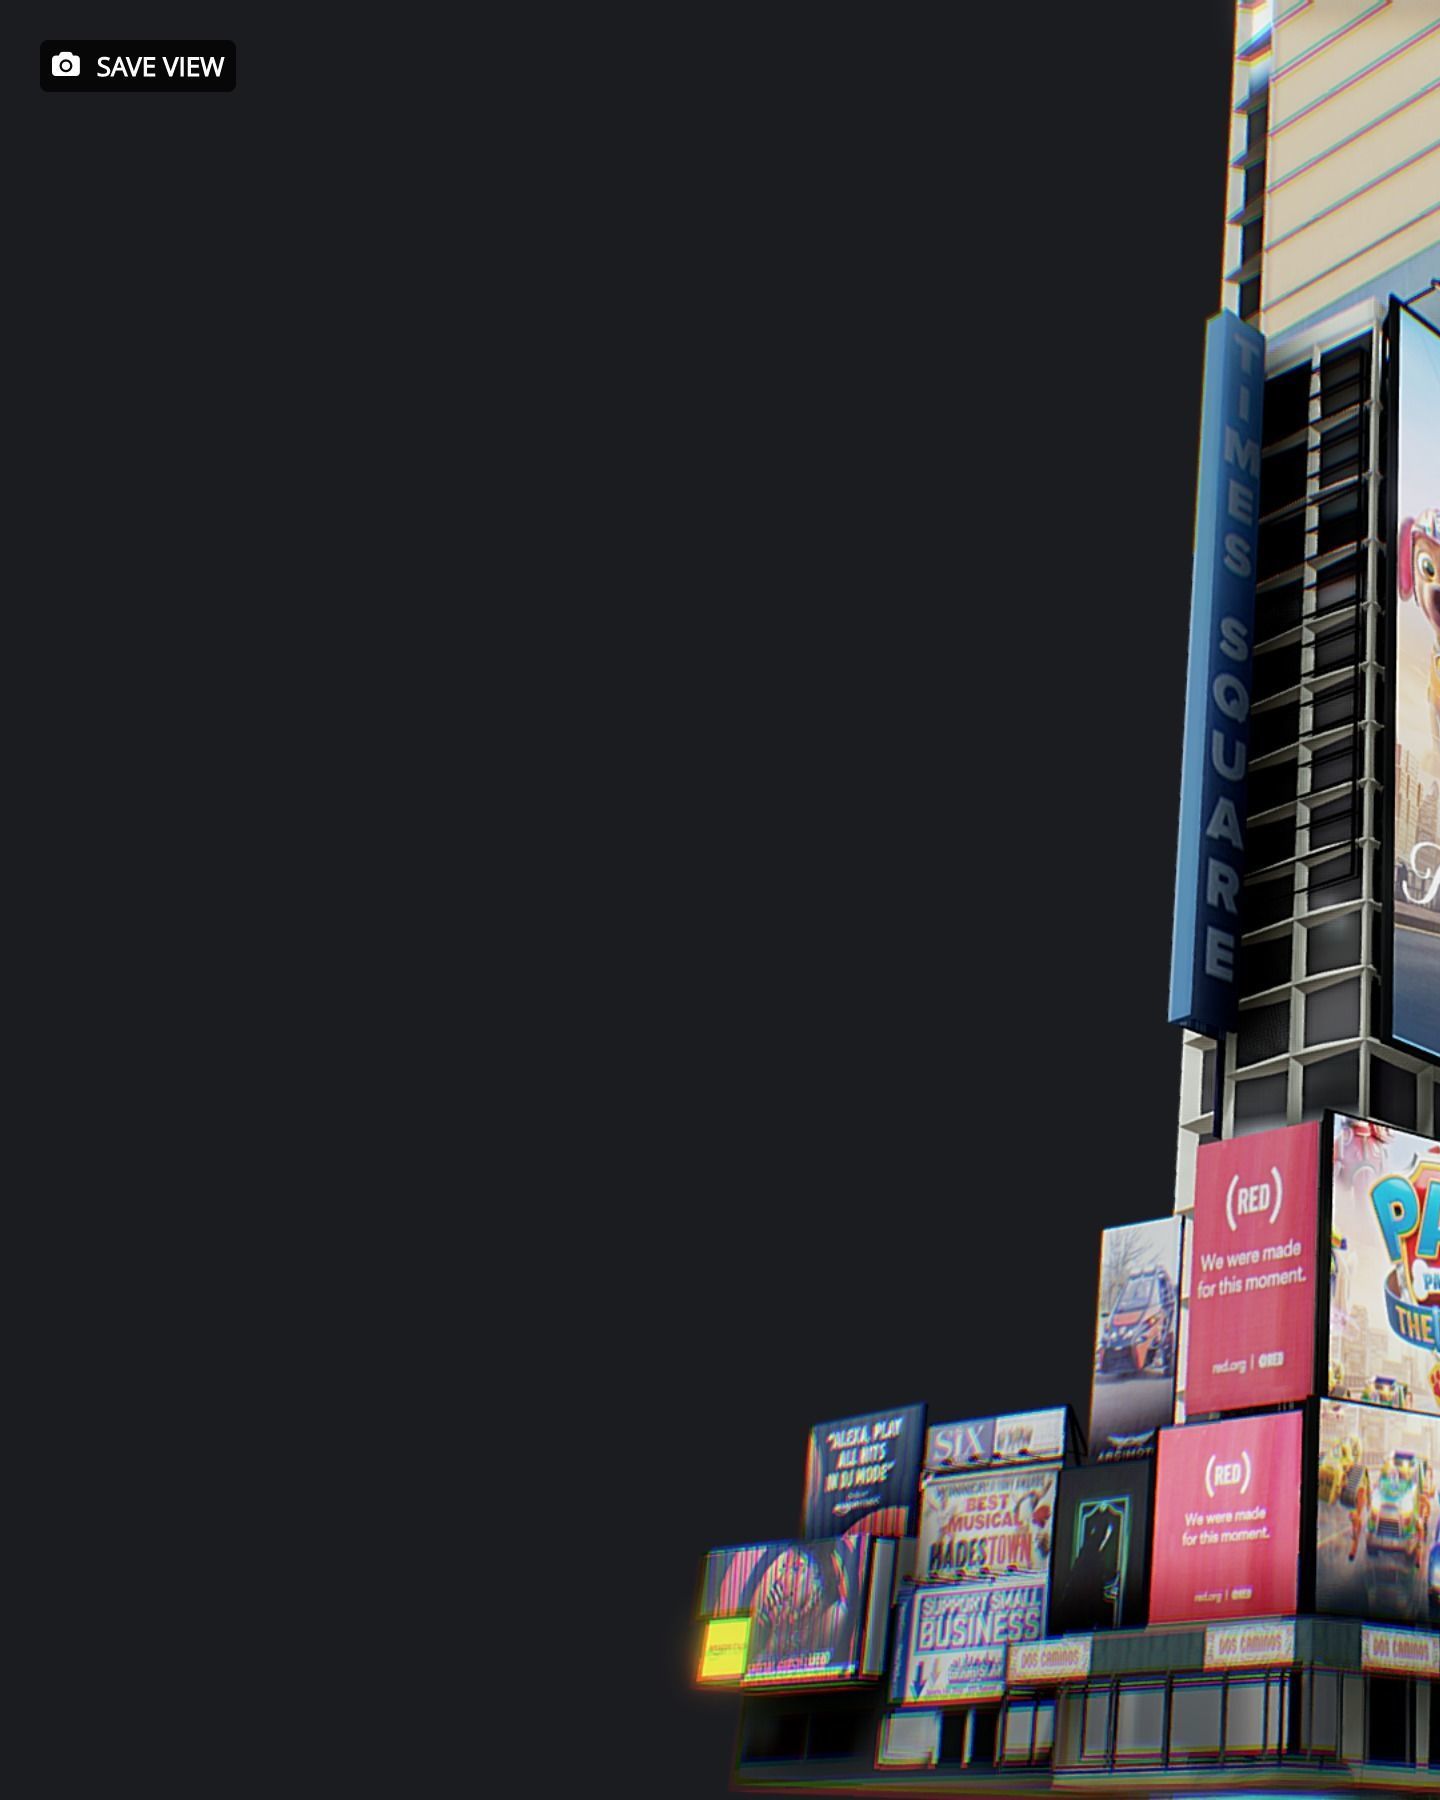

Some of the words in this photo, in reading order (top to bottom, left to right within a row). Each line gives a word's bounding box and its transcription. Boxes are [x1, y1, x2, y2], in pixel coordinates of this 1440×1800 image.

[1222, 332, 1261, 578] TIMES
[1206, 616, 1250, 983] SQUARE
[1226, 1166, 1283, 1232] (RED)
[1201, 1252, 1224, 1272] We
[1227, 1249, 1259, 1268] were
[1262, 1239, 1302, 1262] made
[1197, 1281, 1216, 1299] for
[1219, 1275, 1243, 1295] this
[1245, 1267, 1307, 1290] moment.
[1395, 1305, 1435, 1344] THE
[1204, 1450, 1252, 1498] (RED)
[964, 1493, 1010, 1513] BEST
[1184, 1512, 1203, 1527] We
[1206, 1510, 1233, 1524] were
[1234, 1506, 1267, 1521] made
[947, 1510, 1024, 1533] MUSICAL
[1182, 1532, 1197, 1546] for
[1199, 1529, 1219, 1544] this
[1220, 1526, 1271, 1542] moment.
[928, 1534, 1033, 1571] HADESTOWN
[921, 1593, 988, 1618] SUPPORT
[990, 1589, 1041, 1612] SMALL
[918, 1608, 1041, 1652] BUSINESS
